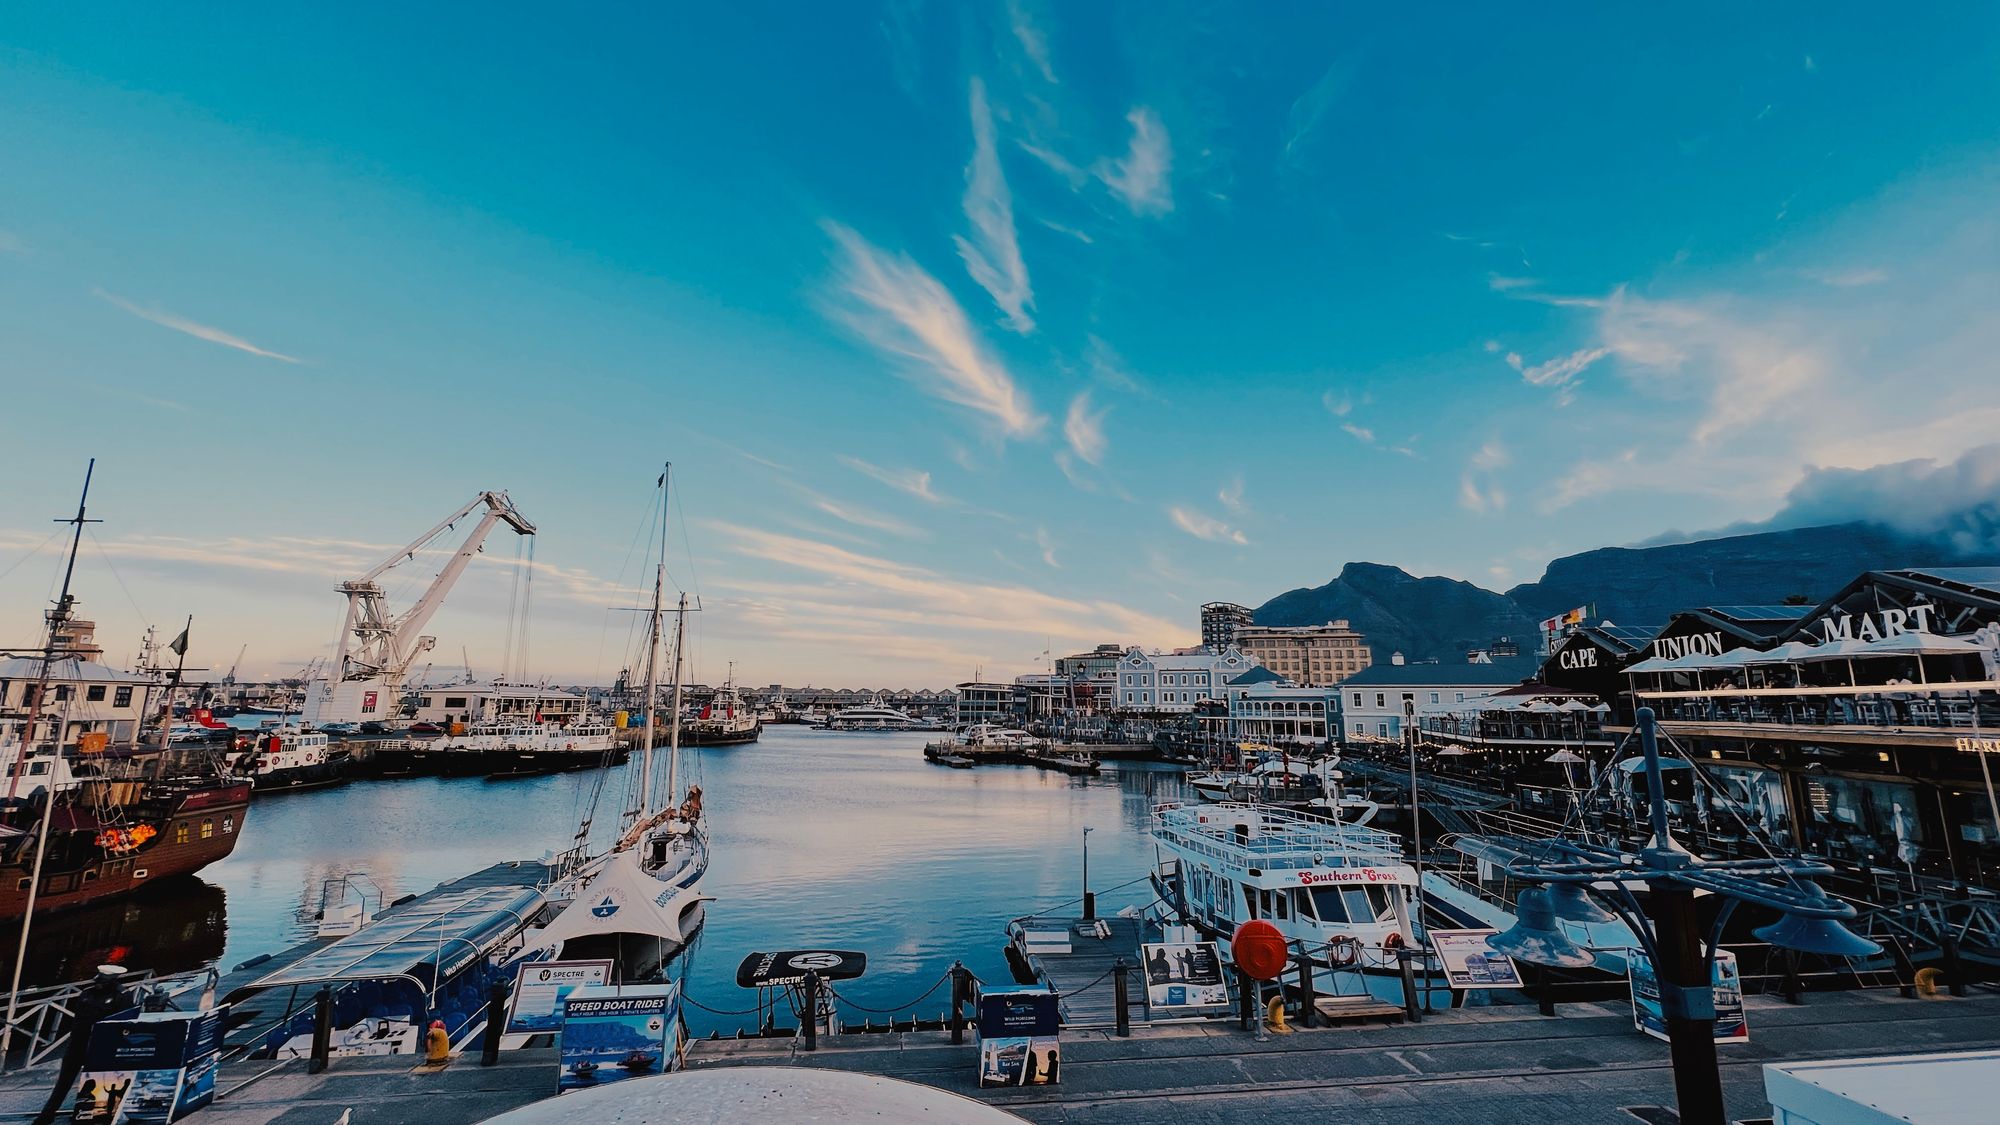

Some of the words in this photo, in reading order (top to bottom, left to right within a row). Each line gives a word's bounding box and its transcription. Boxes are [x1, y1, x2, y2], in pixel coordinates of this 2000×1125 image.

[1560, 647, 1598, 670] CAPE
[1653, 631, 1723, 661] UNION
[1821, 604, 1935, 644] MART
[1298, 870, 1363, 885] Southern
[1362, 868, 1398, 882] Cross
[753, 952, 778, 977] SPECTRE
[552, 970, 585, 978] SPECTRE
[568, 1002, 602, 1012] SPEED
[602, 1000, 634, 1010] BOAT
[633, 999, 665, 1008] RIDES
